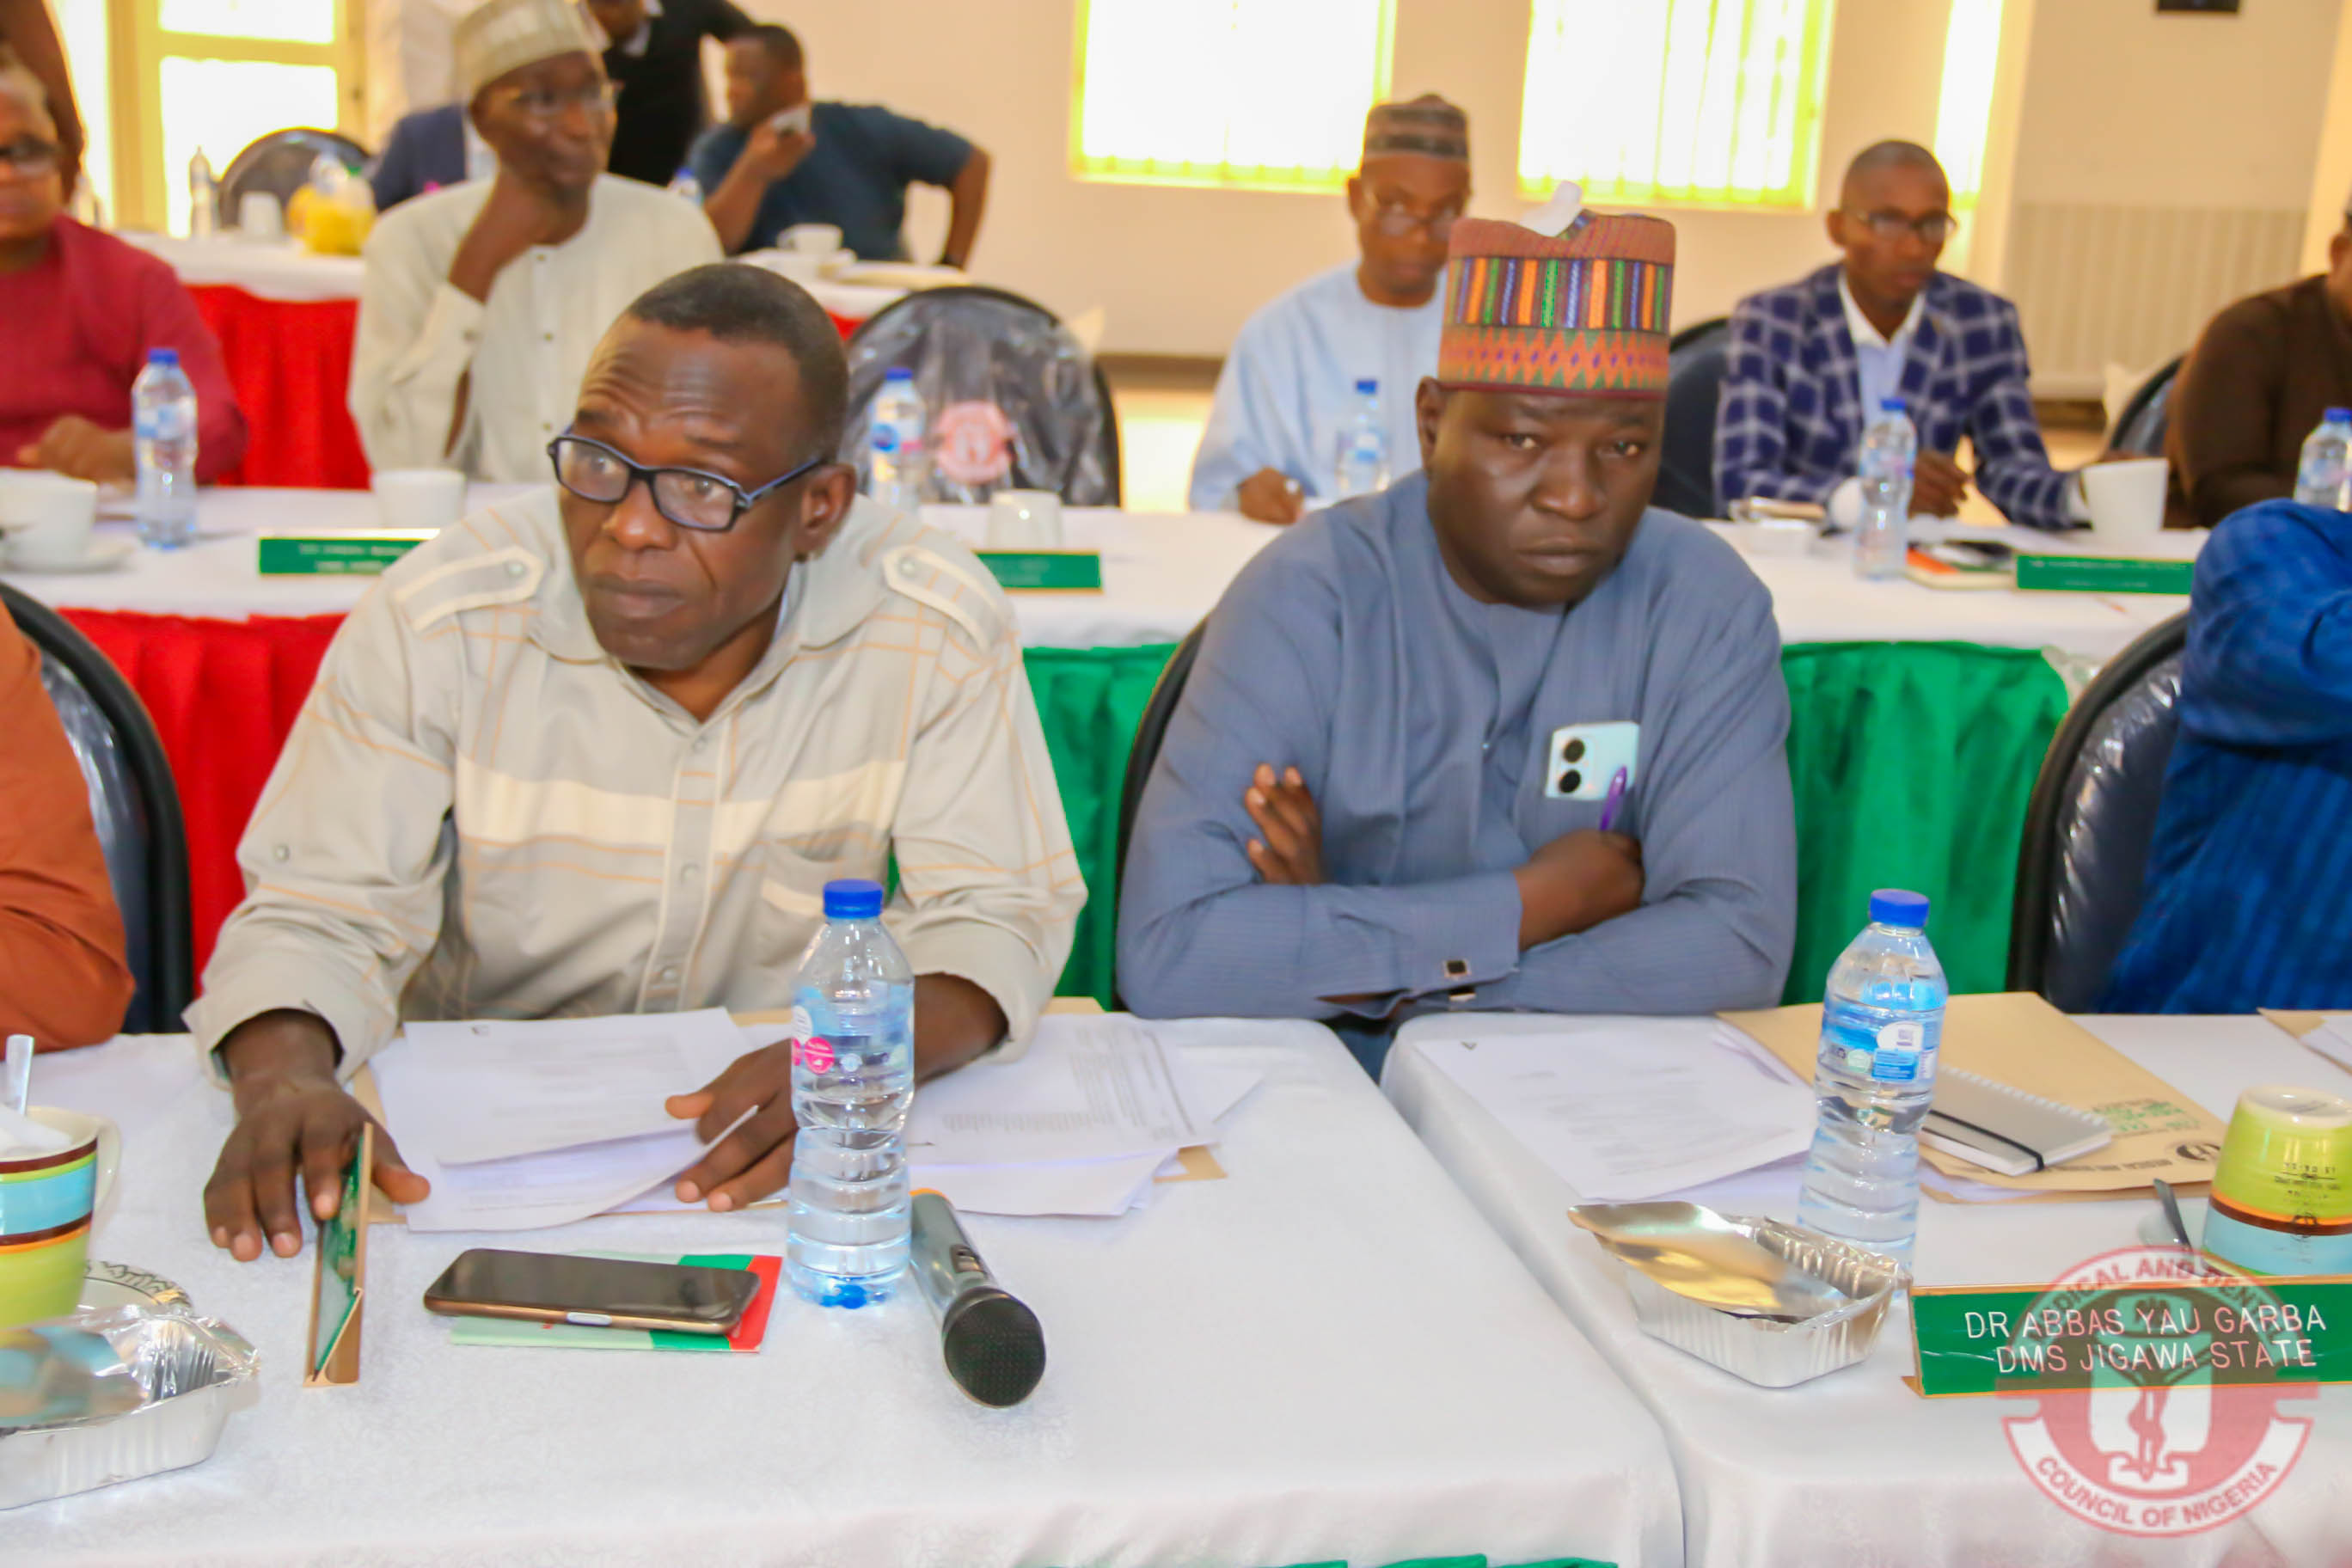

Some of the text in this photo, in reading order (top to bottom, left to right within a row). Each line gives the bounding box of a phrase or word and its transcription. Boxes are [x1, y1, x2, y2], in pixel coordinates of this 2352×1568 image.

[1964, 1303, 2327, 1338] DR ABBAS YAU GARBA
[1996, 1338, 2318, 1374] DMS JIGAWA STATE
